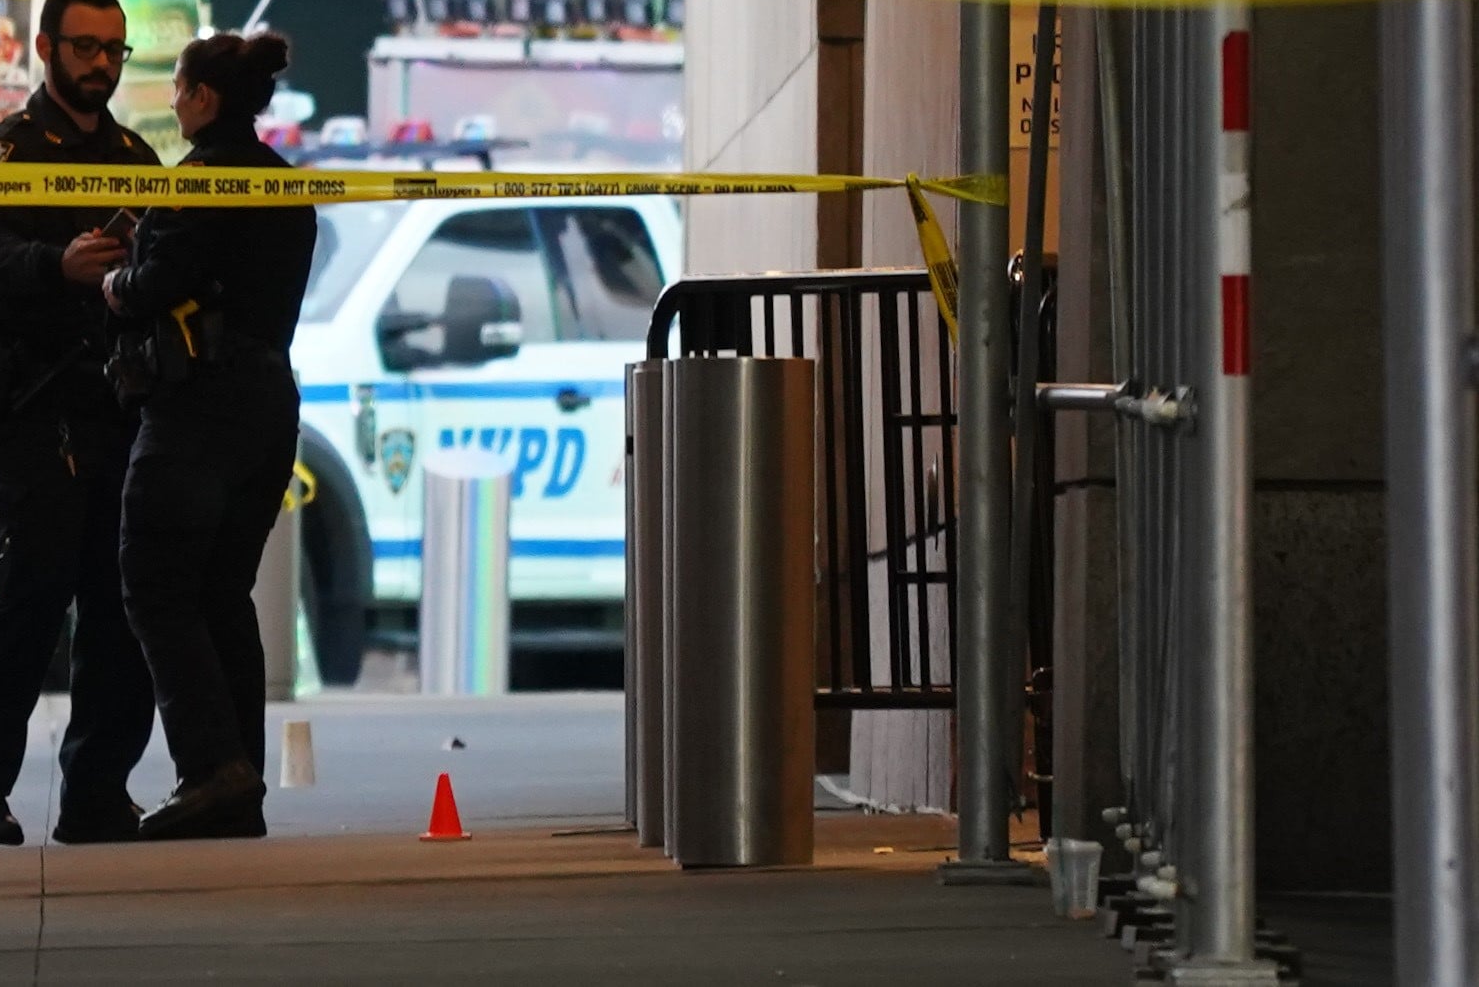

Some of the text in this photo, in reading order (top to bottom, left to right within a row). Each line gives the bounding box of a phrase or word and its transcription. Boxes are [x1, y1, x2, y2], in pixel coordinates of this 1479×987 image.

[43, 175, 132, 195] 1-800-577-TIPS
[134, 175, 170, 196] (8477)
[175, 178, 211, 195] CRIME
[214, 178, 251, 196] SCENE
[264, 179, 279, 196] DO
[283, 179, 305, 196] NOT
[308, 179, 346, 197] CROSS
